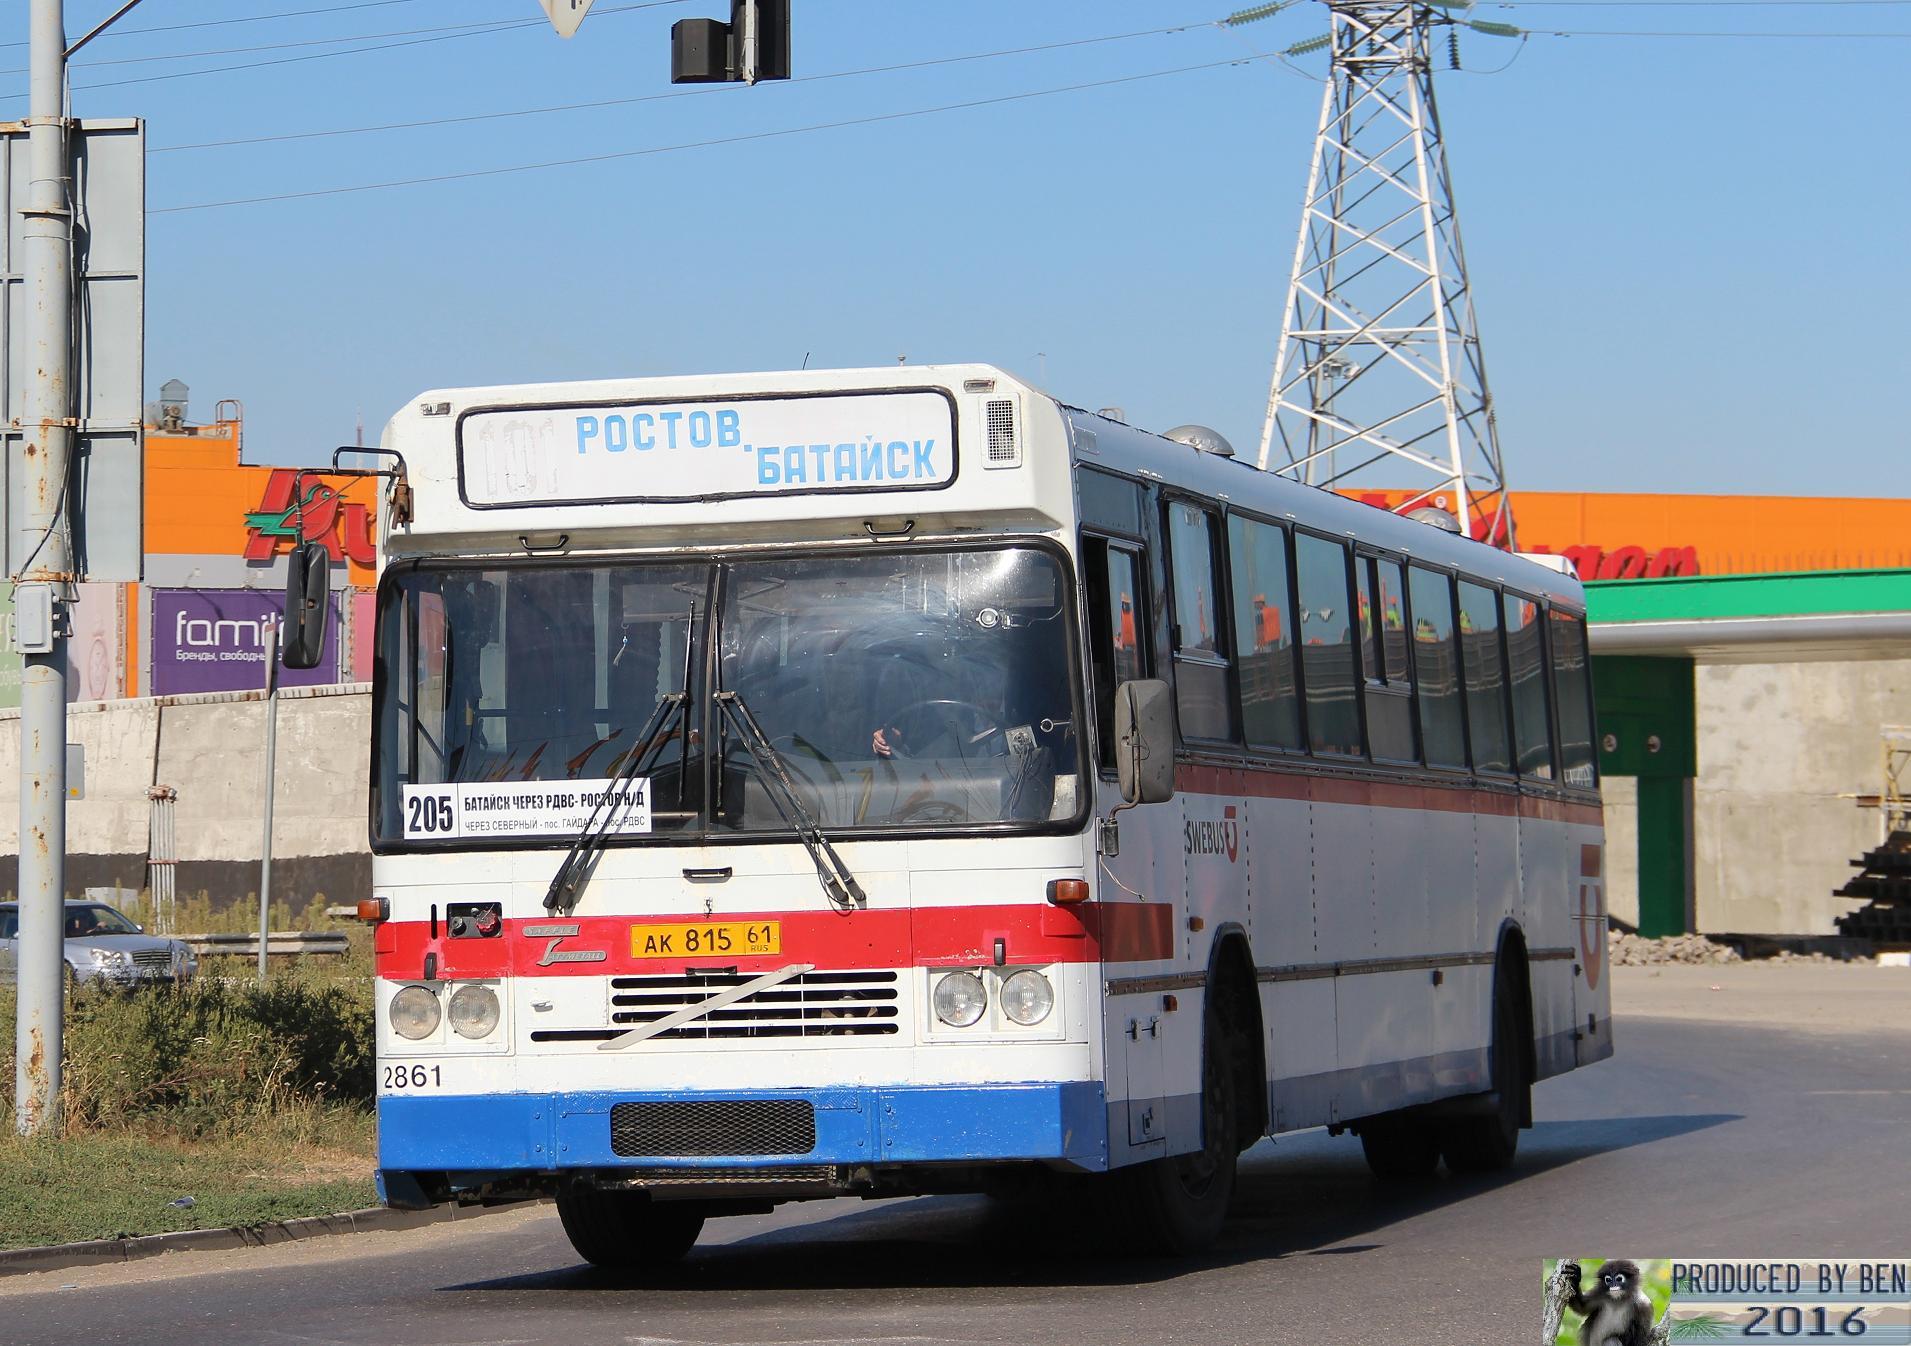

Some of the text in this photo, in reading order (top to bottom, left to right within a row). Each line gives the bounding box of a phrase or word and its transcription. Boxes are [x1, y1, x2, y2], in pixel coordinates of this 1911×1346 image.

[757, 435, 936, 485] БАТАЙСК
[408, 796, 454, 832] 205
[464, 793, 511, 812] БАТАЙСК
[512, 794, 544, 810] ЧЕРЕЗ
[464, 821, 491, 832] ЧЕРЕЗ
[492, 816, 538, 831] СЕВЕРНЫЙ
[544, 820, 560, 829] пос.
[562, 815, 599, 829] ГАЙДАА
[623, 815, 645, 827] РДВС
[1186, 820, 1225, 855] SWEBUS
[685, 927, 732, 952] 815
[747, 925, 771, 944] 61
[750, 944, 769, 952] RUS
[384, 1064, 441, 1089] 2861
